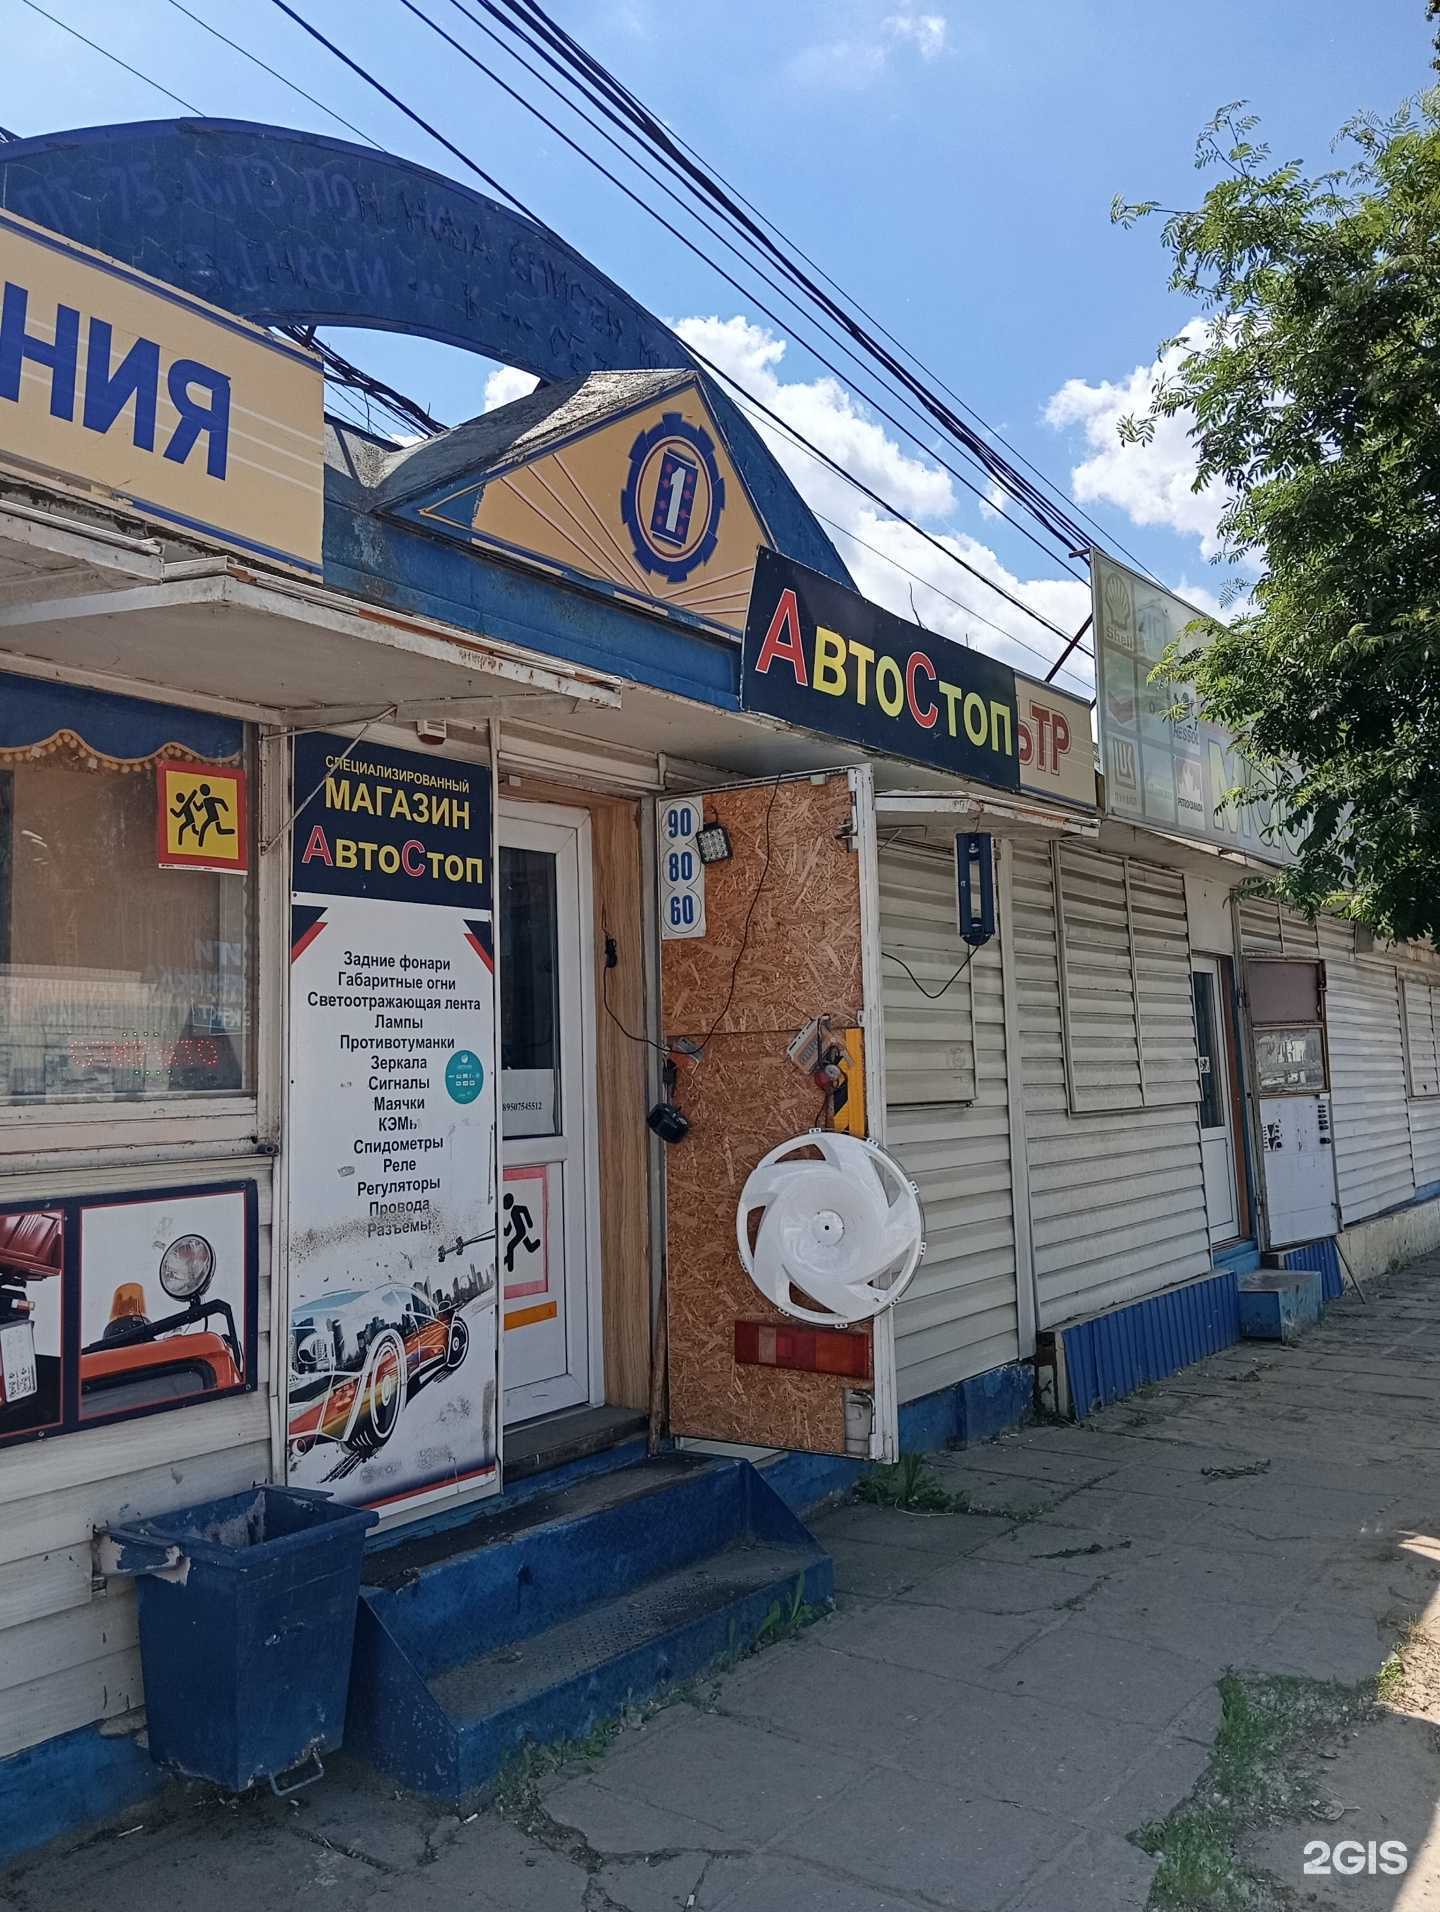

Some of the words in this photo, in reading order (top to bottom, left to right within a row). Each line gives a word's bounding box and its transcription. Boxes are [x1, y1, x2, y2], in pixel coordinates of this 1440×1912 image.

[665, 467, 686, 532] 1
[1106, 624, 1133, 650] Shell
[326, 755, 470, 794] СПЕЦИАЛИЗИРОВАННЫЙ
[325, 777, 470, 830] МАГАЗИН
[667, 807, 692, 838] 90
[668, 851, 693, 882] 80
[670, 895, 695, 926] 60
[343, 950, 396, 969] Задние
[399, 954, 451, 973] фонари
[338, 971, 424, 990] Габаритные
[426, 976, 457, 991] огни
[307, 991, 442, 1011] Светоотражающая
[444, 997, 481, 1011] лента
[374, 1014, 423, 1031] Лампы
[340, 1034, 456, 1051] Противотуманки
[370, 1055, 428, 1071] Зеркала
[368, 1075, 430, 1091] Сигналы
[374, 1096, 426, 1112] Маячки
[353, 1136, 444, 1156] Спидометры
[383, 1158, 417, 1173] Реле
[357, 1177, 441, 1198] Регуляторы
[369, 1198, 431, 1217] Провода
